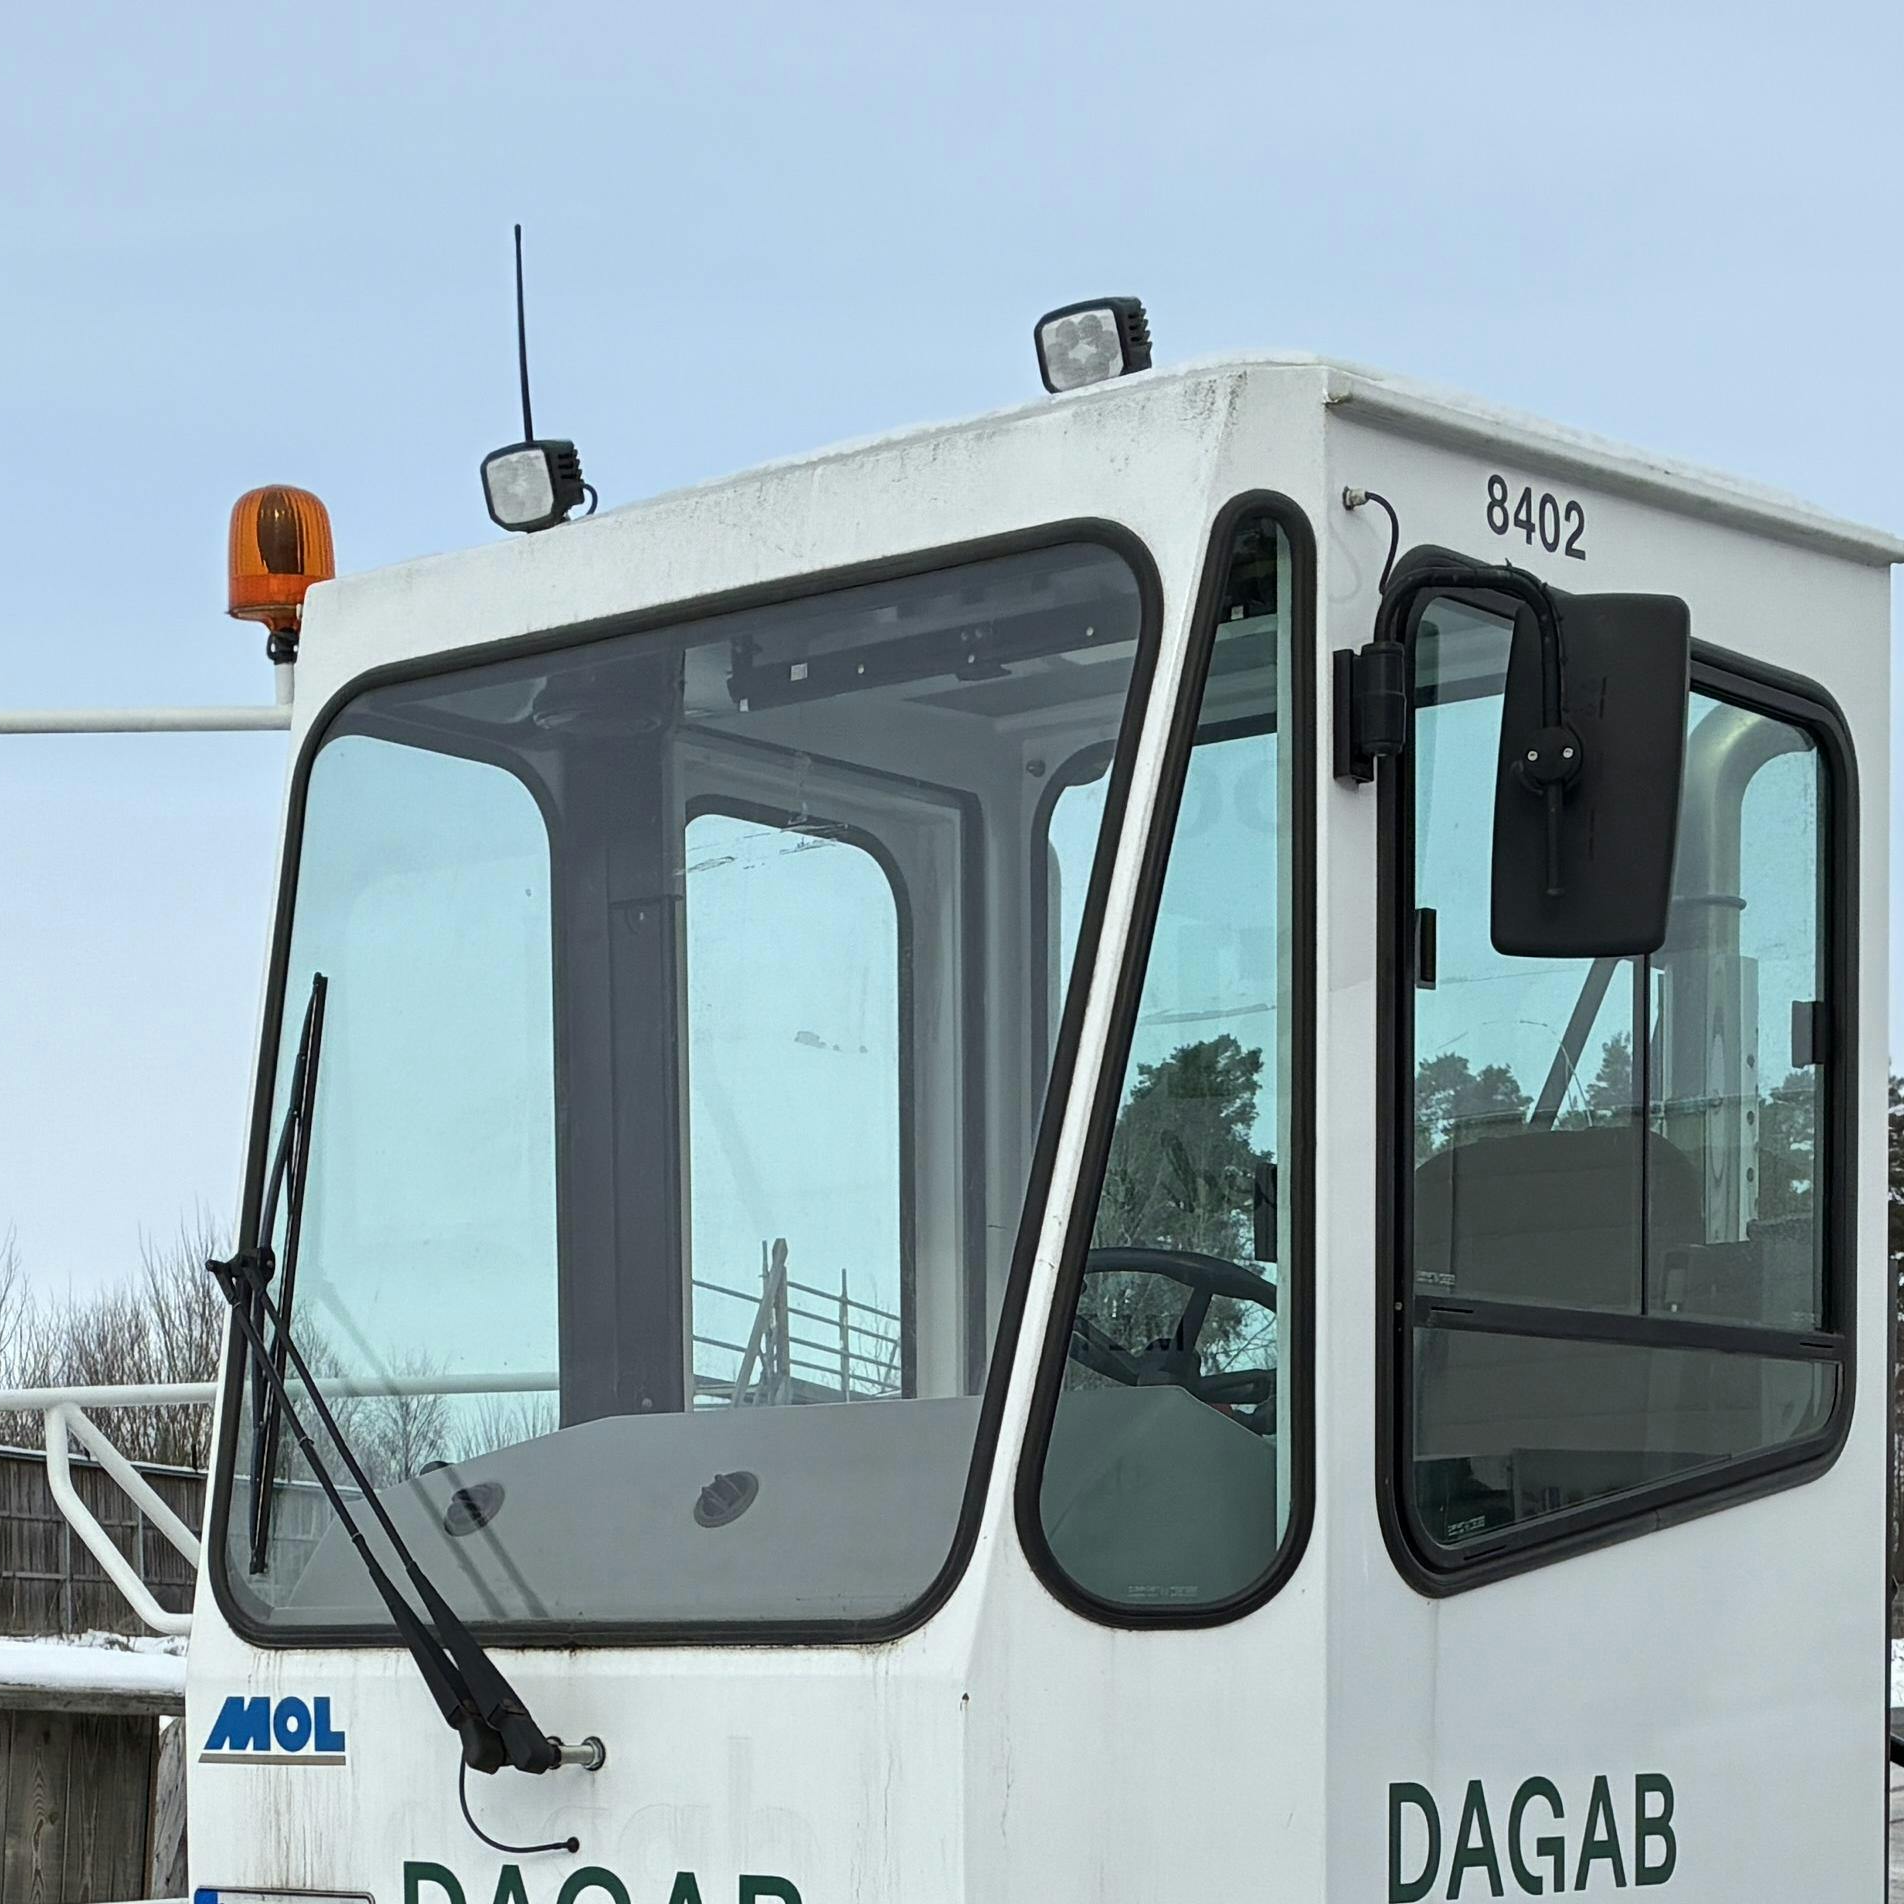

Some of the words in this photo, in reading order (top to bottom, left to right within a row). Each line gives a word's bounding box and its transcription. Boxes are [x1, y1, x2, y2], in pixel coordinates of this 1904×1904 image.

[1486, 474, 1587, 561] 8402
[204, 1696, 346, 1753] MOL
[1388, 1773, 1678, 1904] DAGAB
